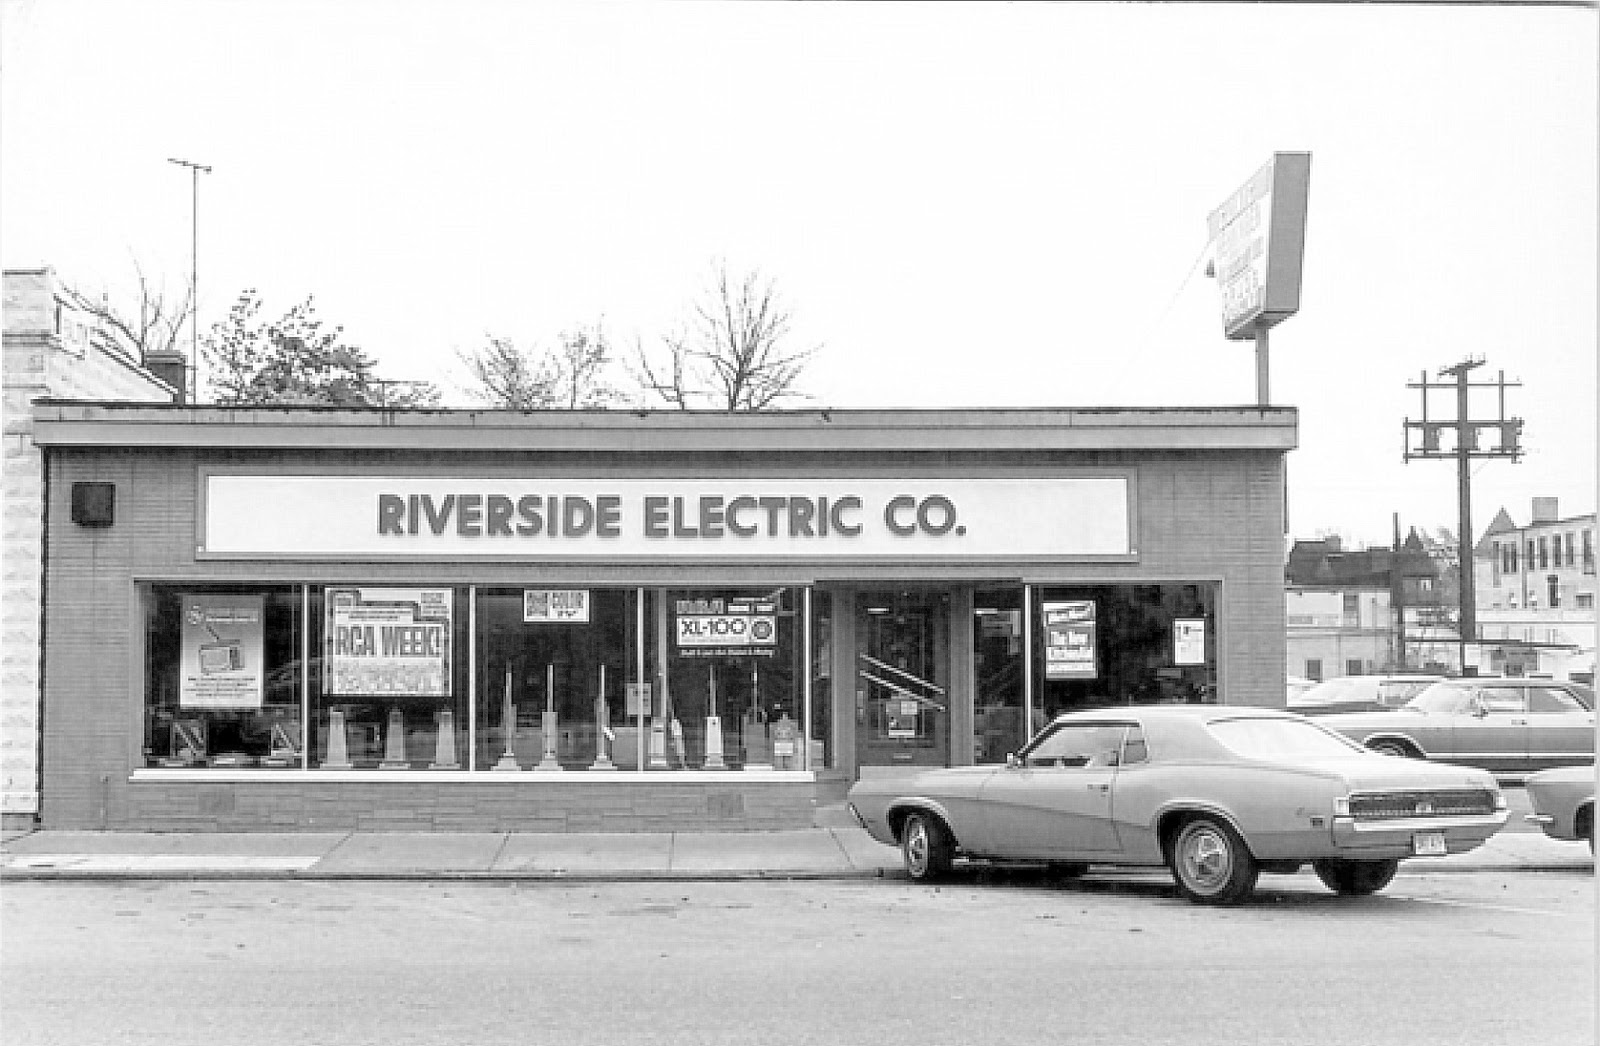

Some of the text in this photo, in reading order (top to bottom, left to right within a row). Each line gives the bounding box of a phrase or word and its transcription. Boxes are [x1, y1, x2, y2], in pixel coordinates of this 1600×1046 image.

[378, 494, 966, 537] RIVERSIDE ELECTRIC CO.
[335, 626, 375, 656] RCA
[680, 618, 747, 637] XL-100
